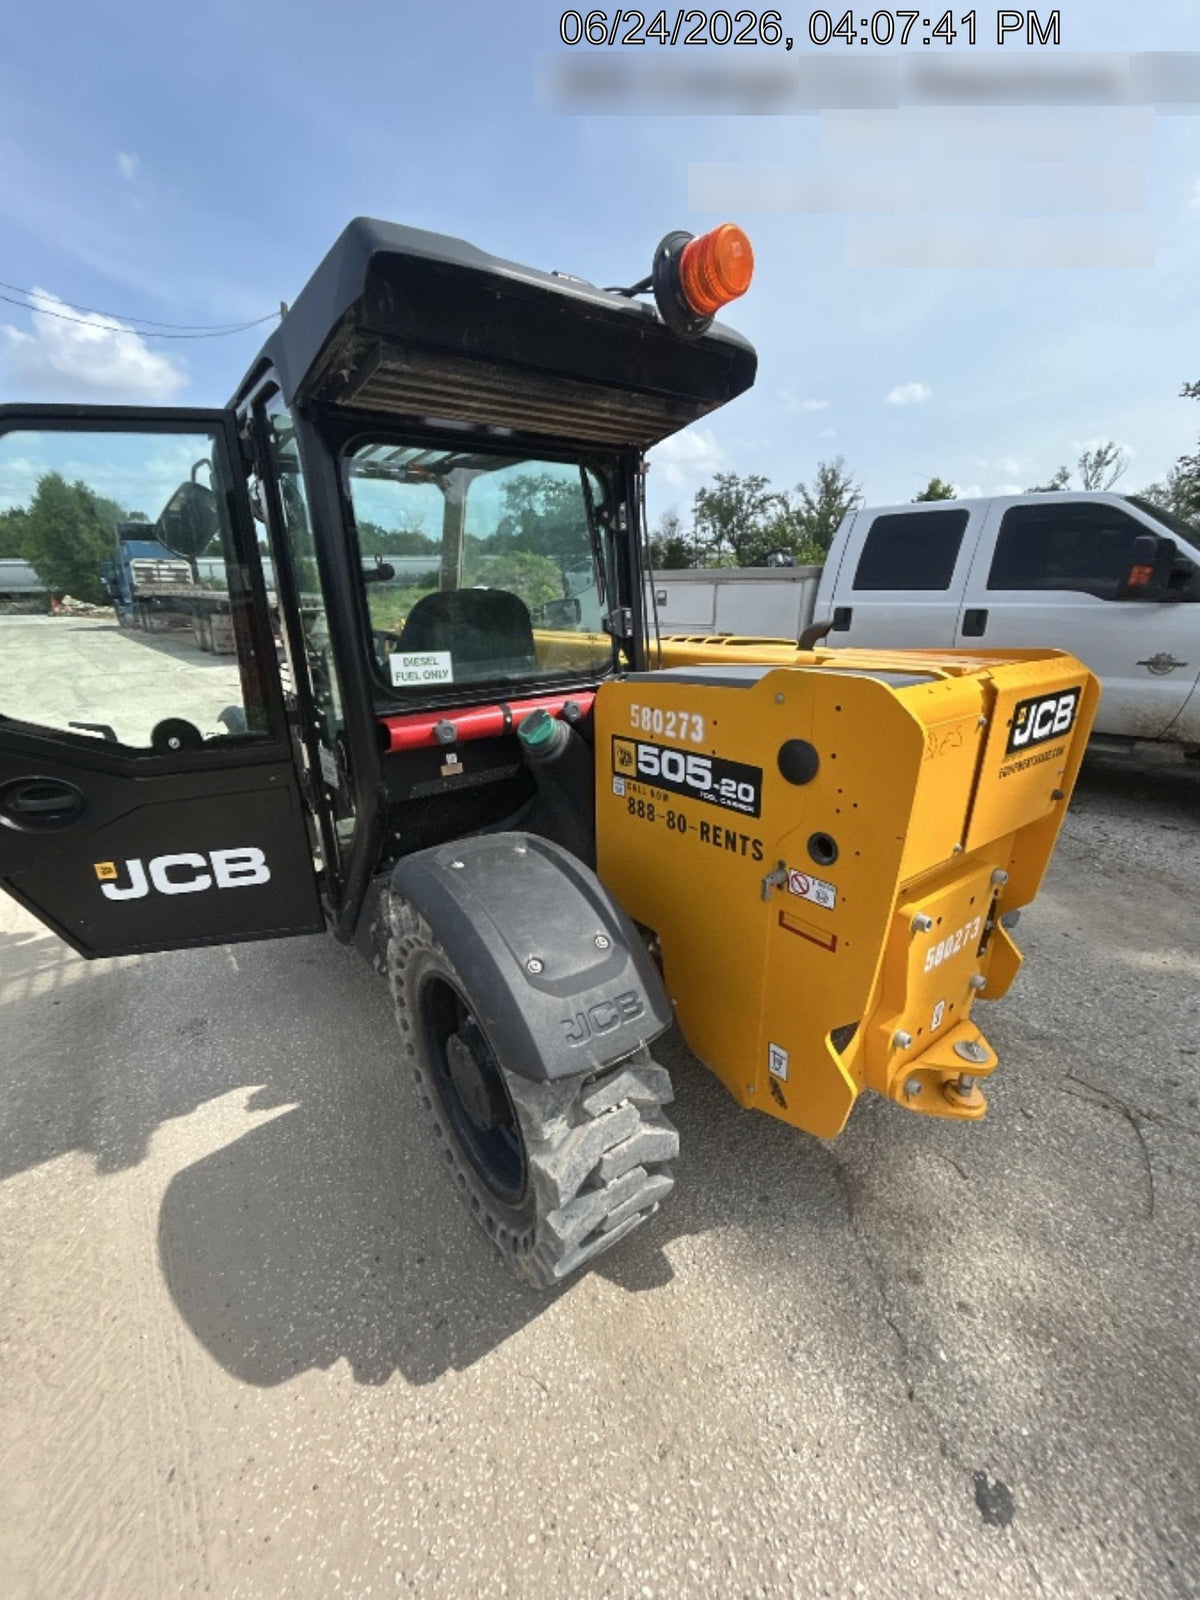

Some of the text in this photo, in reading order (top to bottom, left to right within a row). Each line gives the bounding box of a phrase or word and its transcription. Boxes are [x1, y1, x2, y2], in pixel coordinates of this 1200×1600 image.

[395, 669, 449, 682] FUEL ONLY
[402, 656, 439, 667] DIESEL
[629, 703, 704, 743] 580273
[1012, 694, 1076, 746] JCB
[627, 796, 764, 862] 888-80-RENTS
[100, 846, 271, 900] JCB
[924, 916, 981, 973] 580273
[563, 989, 645, 1048] JCB
